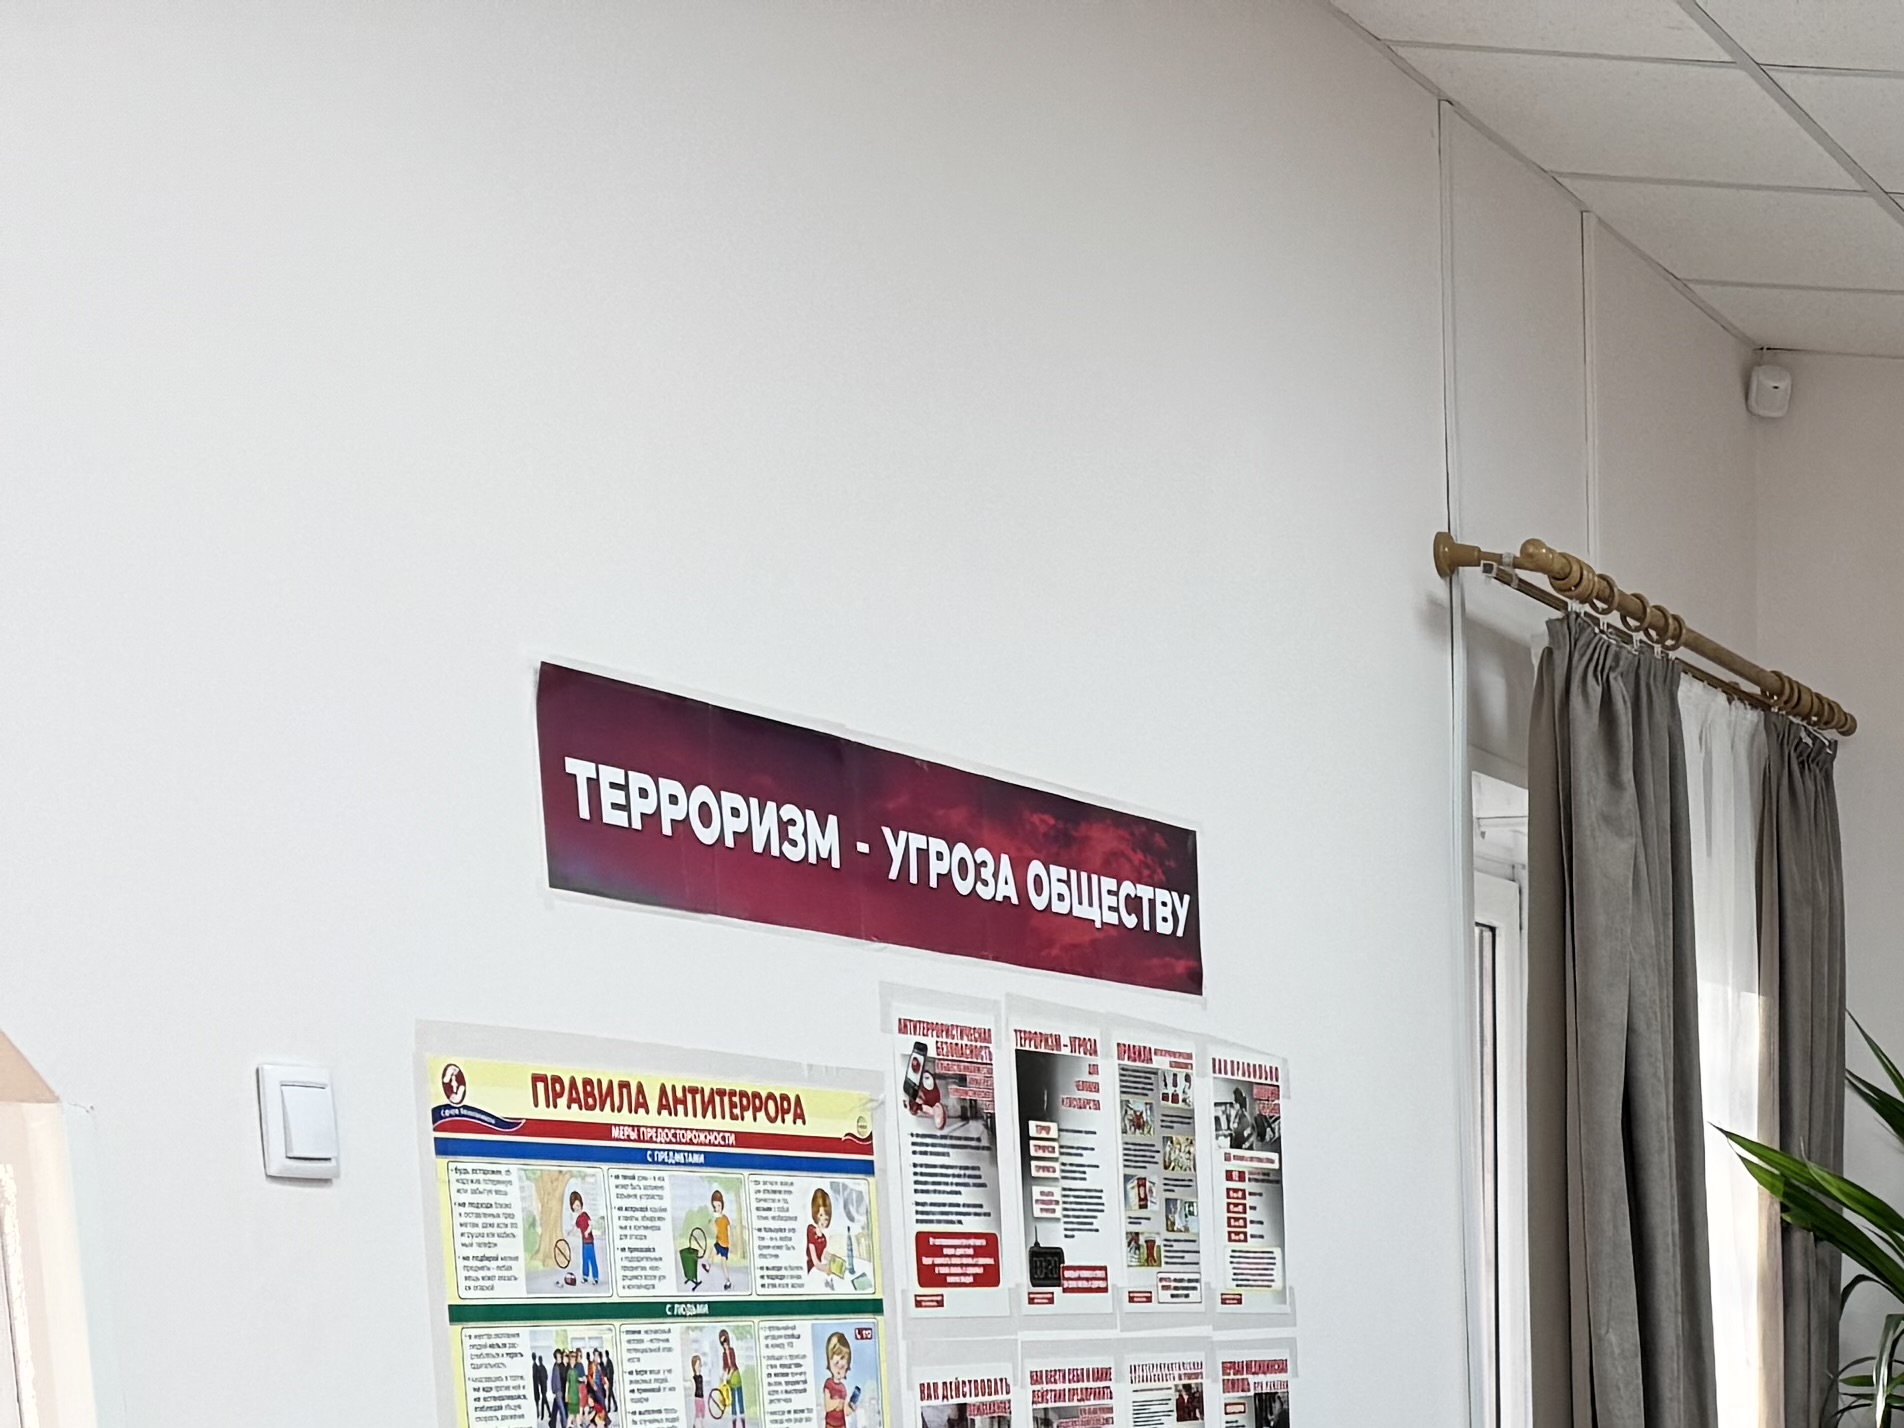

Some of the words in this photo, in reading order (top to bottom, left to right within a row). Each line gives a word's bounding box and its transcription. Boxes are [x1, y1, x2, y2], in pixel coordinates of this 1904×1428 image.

[565, 756, 840, 868] ТЕРРОРИЗМ
[857, 841, 870, 854] -
[881, 826, 1019, 904] УГРОЗА
[1026, 859, 1190, 937] ОБЩЕСТВУ
[531, 1072, 649, 1116] ПРАВИЛА
[656, 1083, 806, 1126] АНТИТЕРРОРА
[611, 1125, 637, 1140] МЕРЫ
[639, 1128, 736, 1146] ПРЕДОСТОРОЖНОСТИ
[674, 1304, 708, 1316] ЛЮДЬМИ
[942, 1377, 1010, 1402] ДЕЙСТВОВАТЬ
